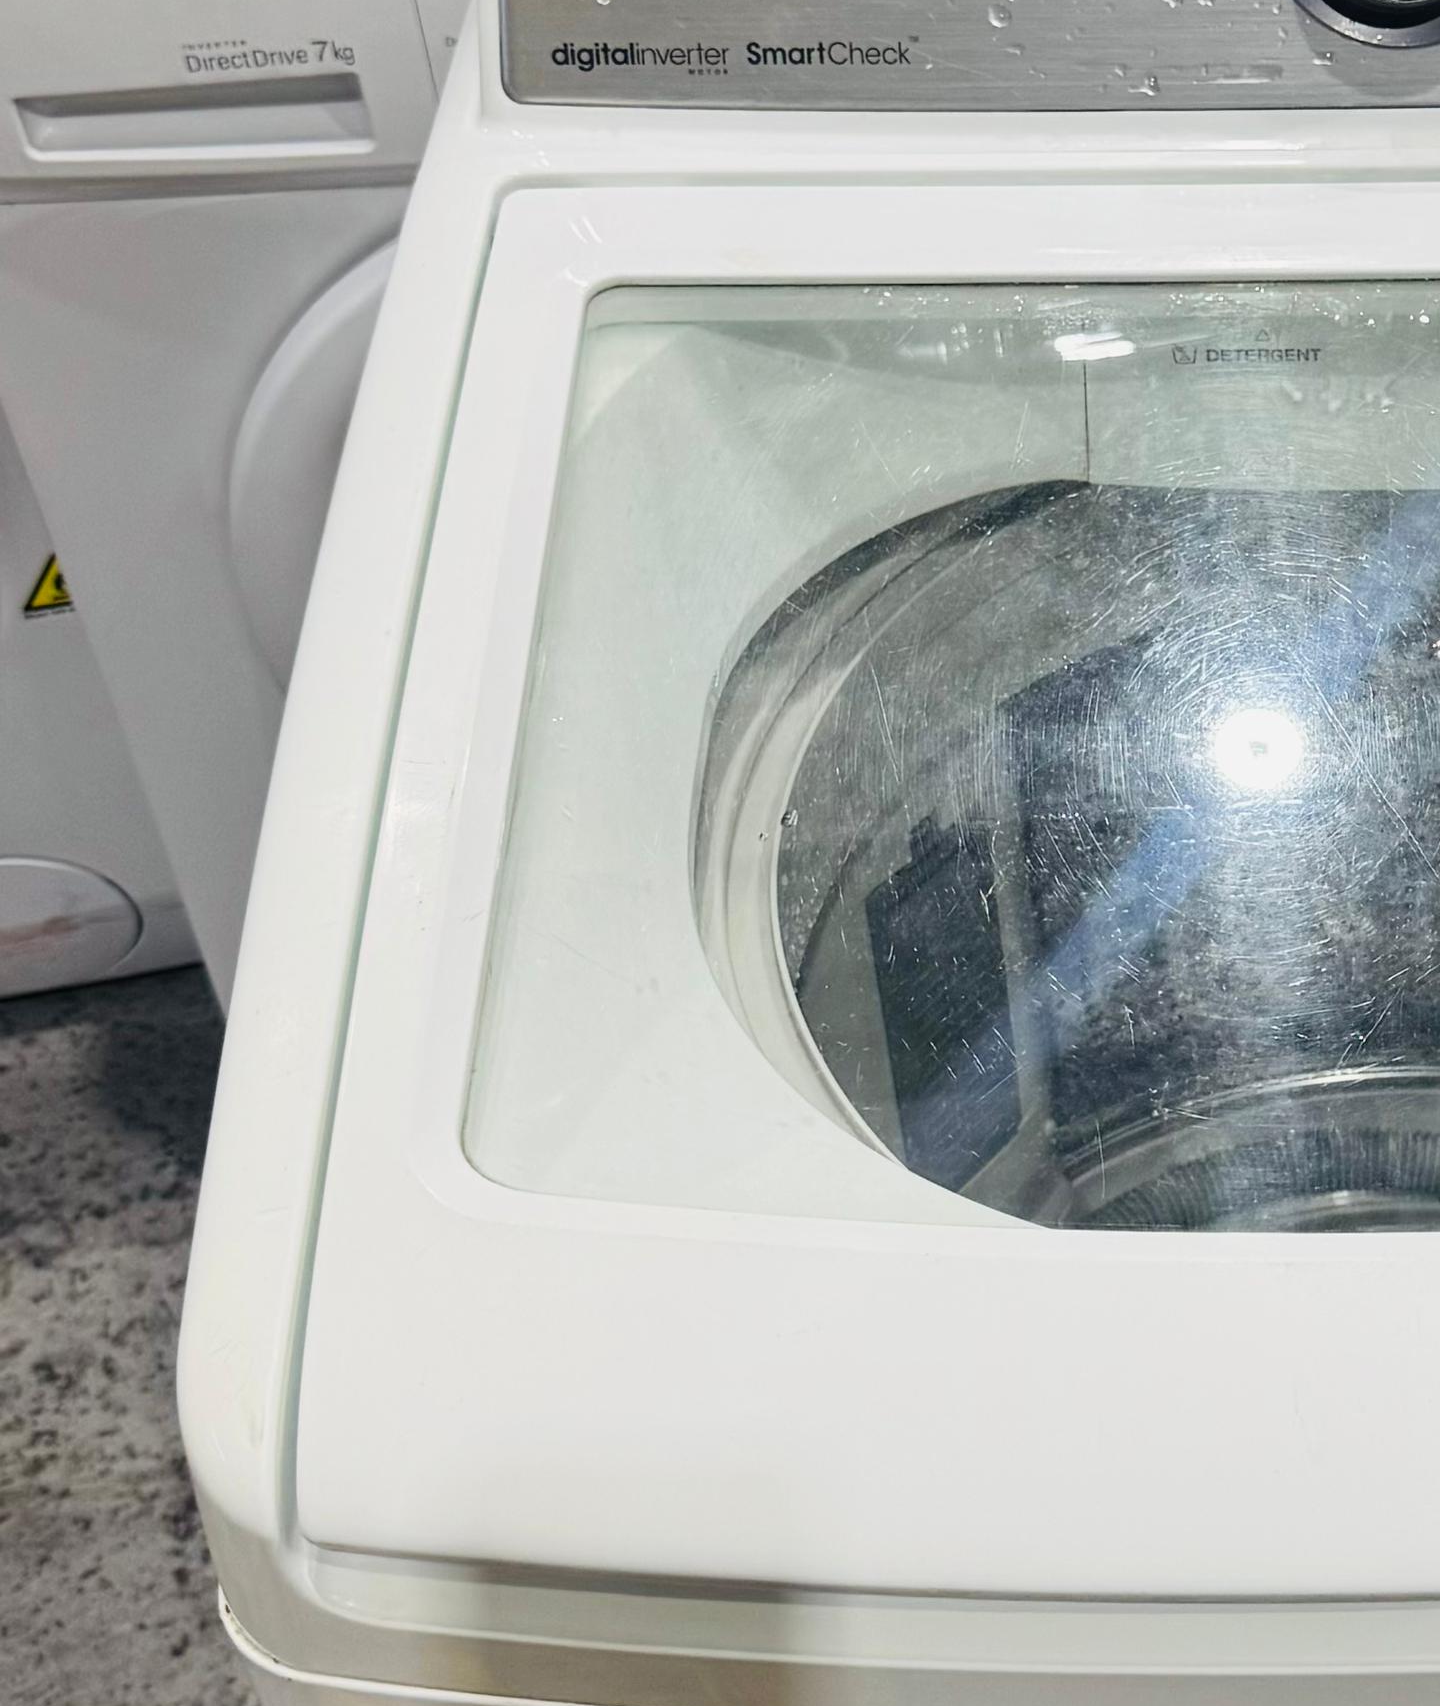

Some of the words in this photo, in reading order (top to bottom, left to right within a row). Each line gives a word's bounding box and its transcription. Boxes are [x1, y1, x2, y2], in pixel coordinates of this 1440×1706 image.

[311, 40, 330, 62] 7
[331, 40, 356, 66] kg
[1206, 348, 1321, 364] DETERGENT
